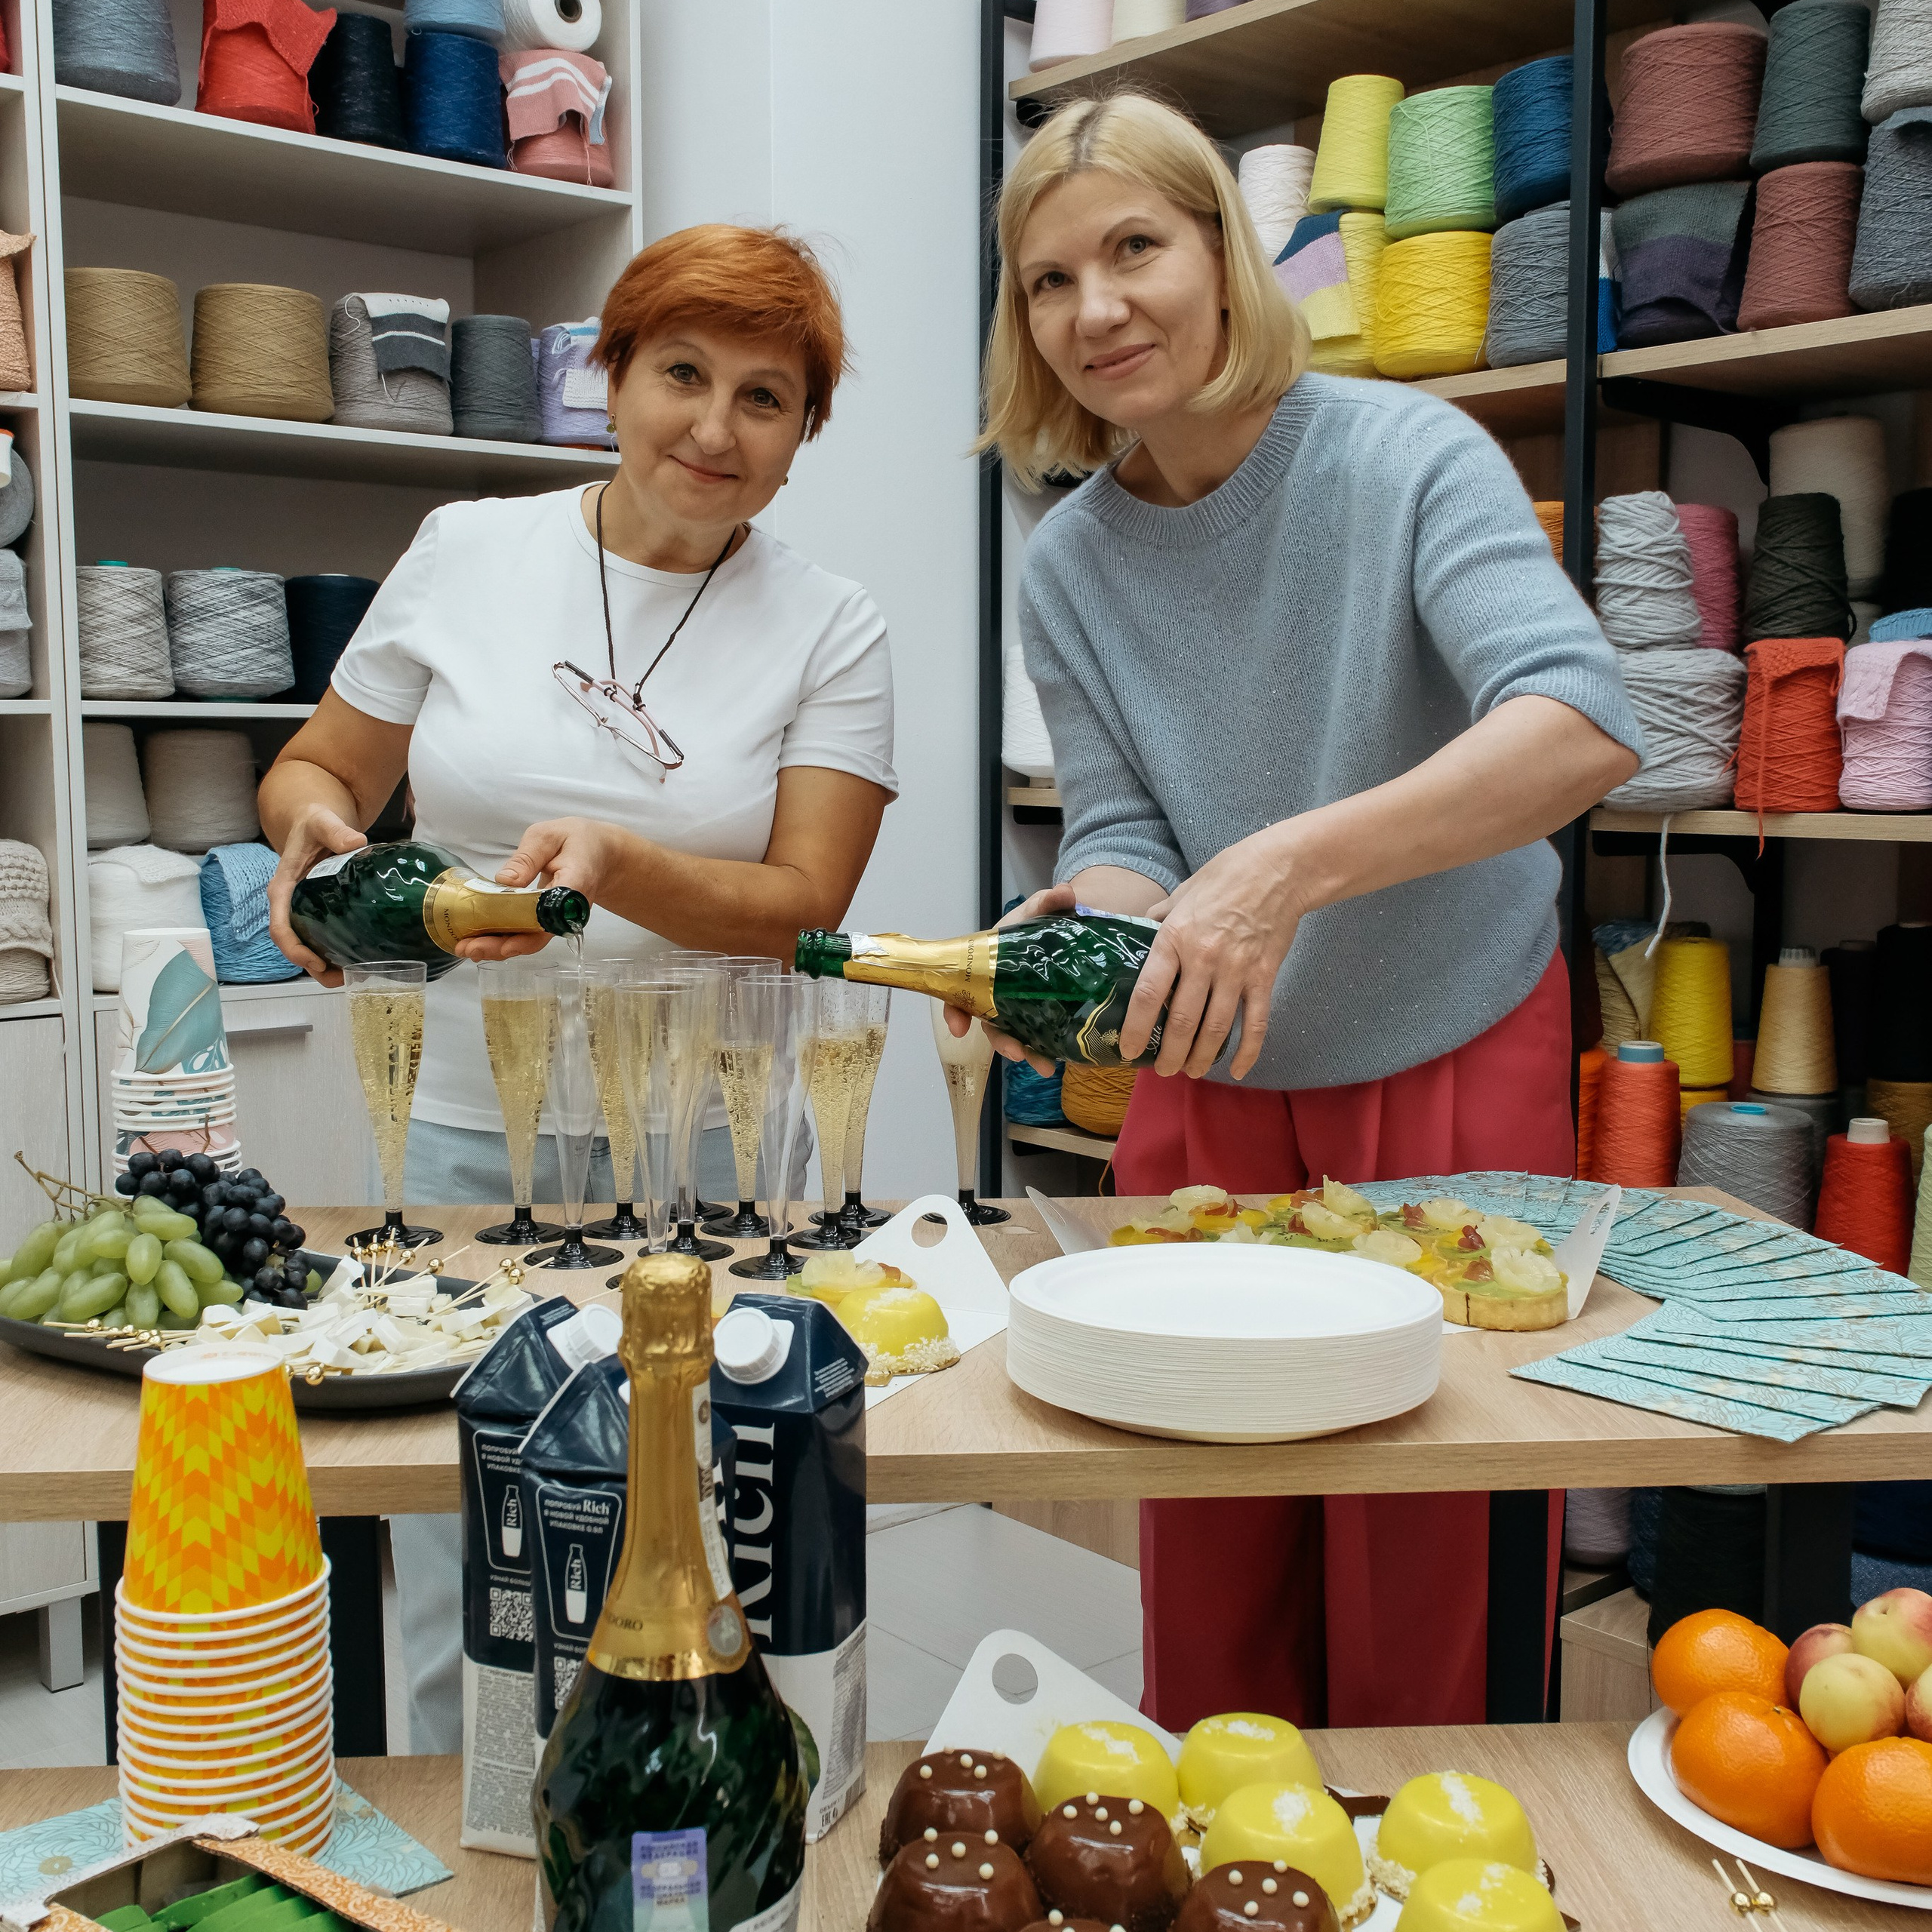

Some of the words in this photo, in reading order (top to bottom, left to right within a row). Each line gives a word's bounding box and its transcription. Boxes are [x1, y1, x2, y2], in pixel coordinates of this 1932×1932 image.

[964, 939, 975, 983] MONDORO
[506, 1498, 518, 1527] Rich
[583, 1499, 610, 1515] Rich
[571, 1558, 582, 1590] Rich
